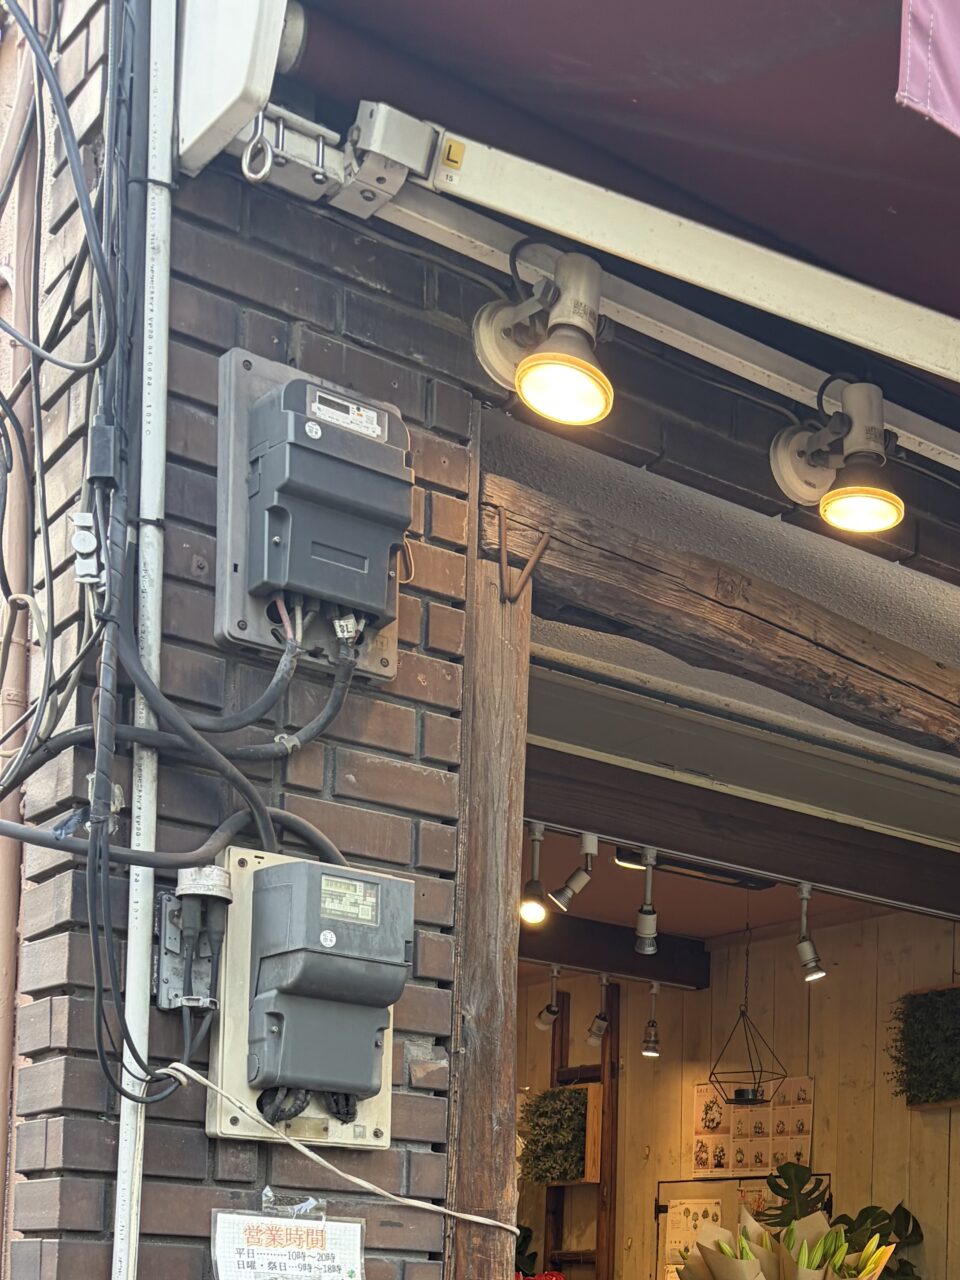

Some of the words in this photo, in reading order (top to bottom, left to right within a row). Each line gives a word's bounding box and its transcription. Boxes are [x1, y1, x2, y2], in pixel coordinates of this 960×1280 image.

[446, 144, 459, 164] L
[243, 1224, 326, 1250] 営業時間
